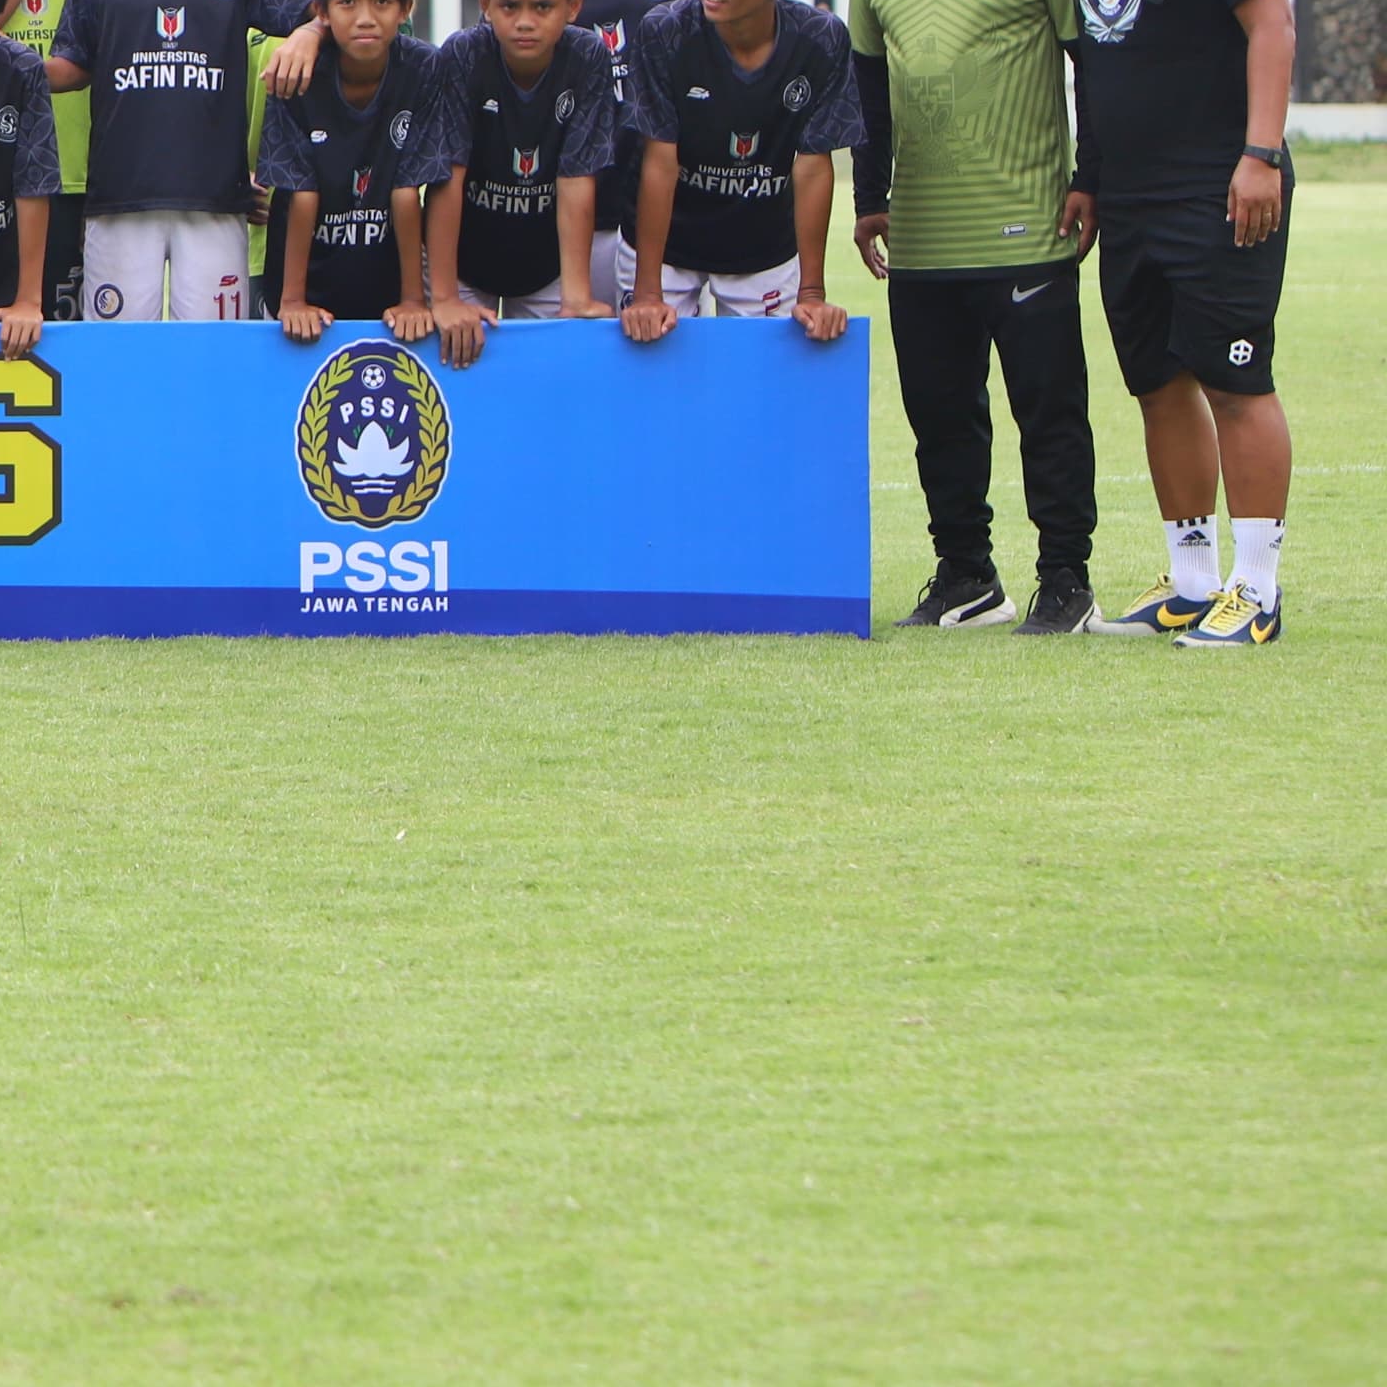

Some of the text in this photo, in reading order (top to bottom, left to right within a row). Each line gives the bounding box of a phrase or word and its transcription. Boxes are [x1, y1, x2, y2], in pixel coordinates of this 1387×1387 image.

[132, 51, 207, 64] UNIVERSITAS
[114, 64, 176, 91] SAFIN
[340, 396, 409, 424] PSSI
[300, 540, 448, 593] PSSI
[301, 597, 449, 613] JAWA TENGAH
